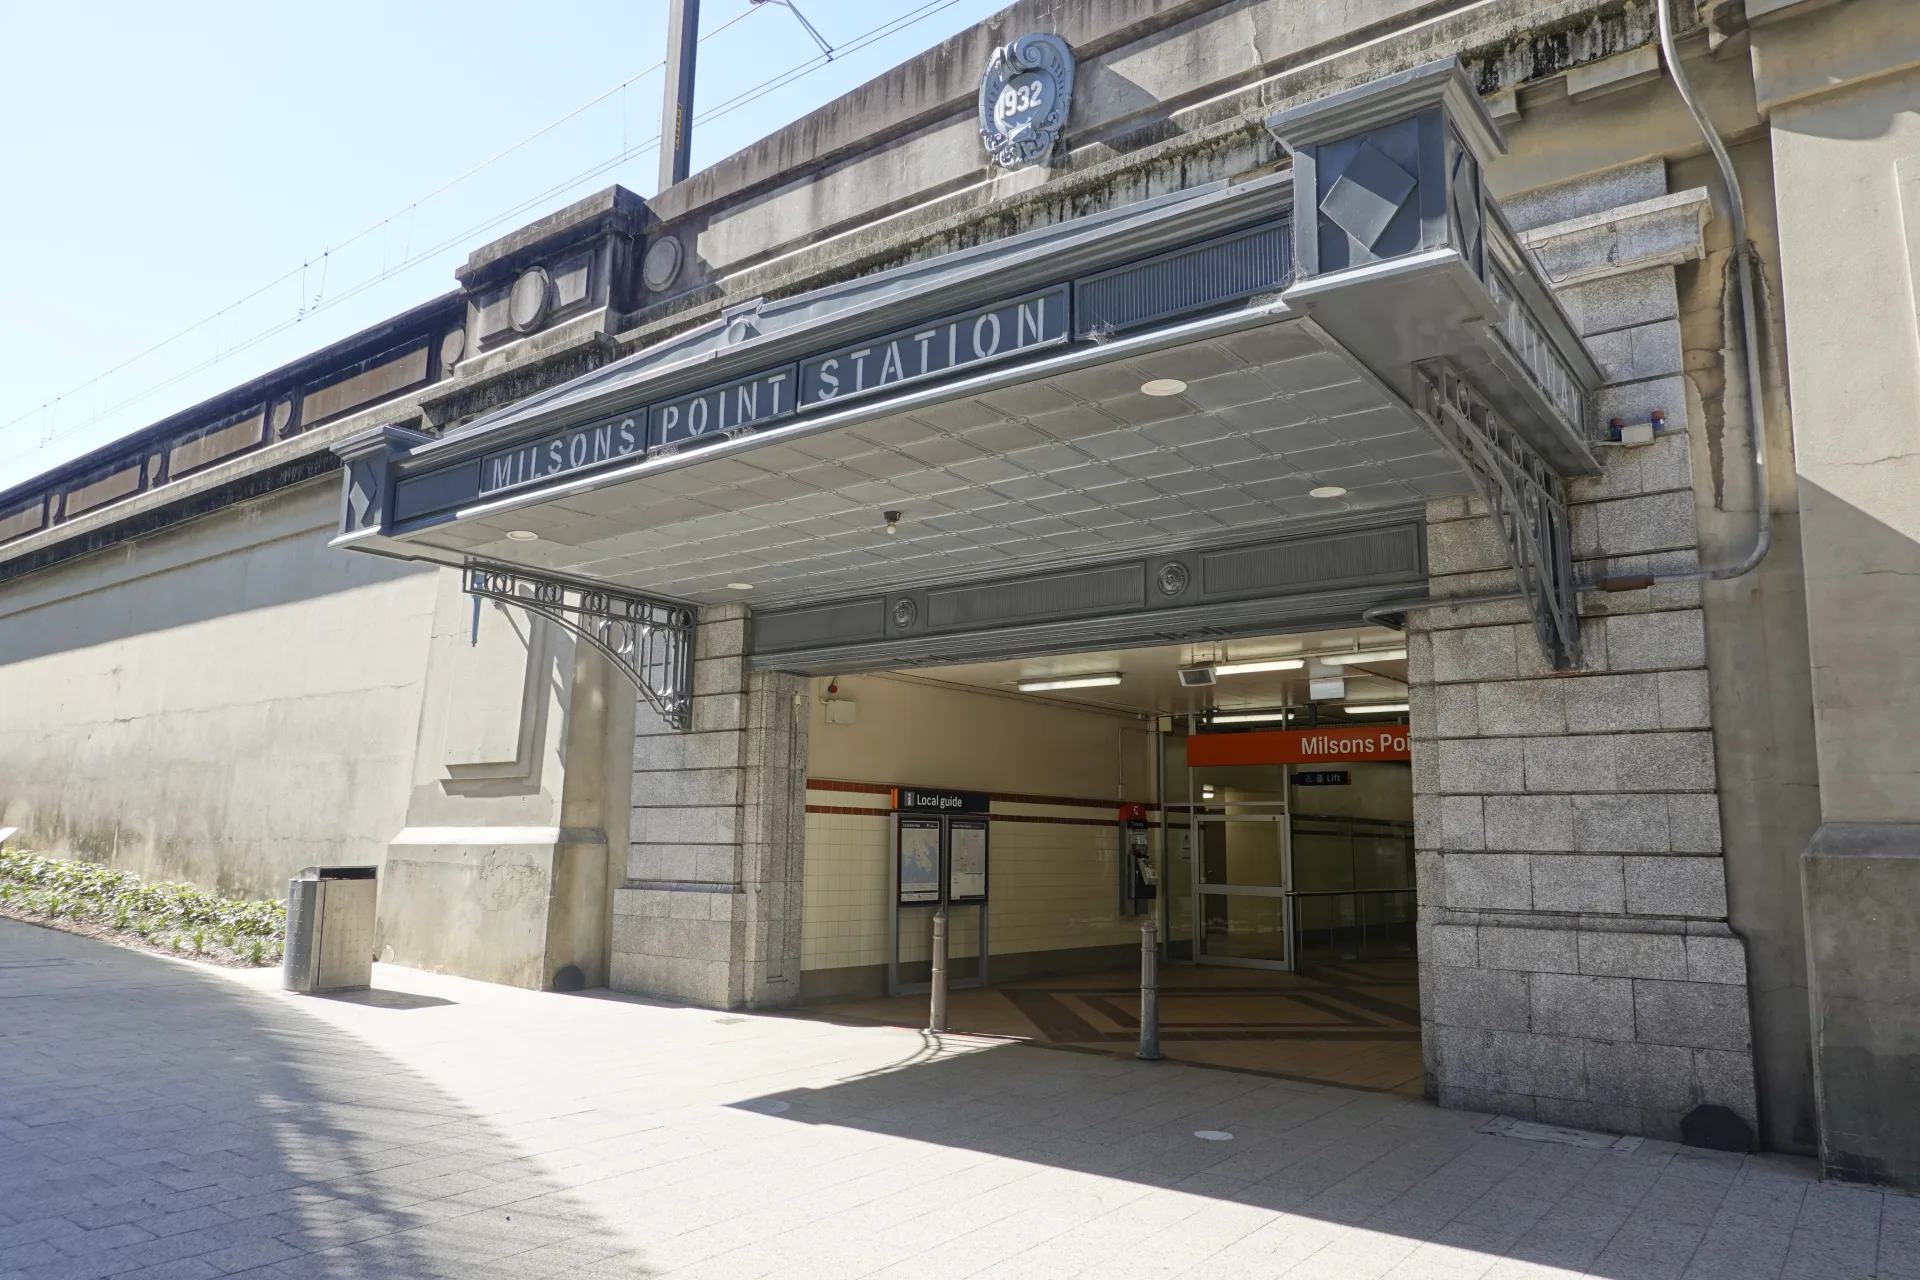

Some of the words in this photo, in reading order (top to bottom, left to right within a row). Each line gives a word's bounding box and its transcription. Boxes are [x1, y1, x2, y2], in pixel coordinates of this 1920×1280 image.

[999, 80, 1042, 120] 1932
[492, 418, 636, 490] MILSONS
[662, 374, 786, 443] POINT
[818, 297, 1045, 401] STATION
[1301, 736, 1375, 755] Milsons
[917, 794, 939, 806] Local
[940, 796, 962, 809] guide
